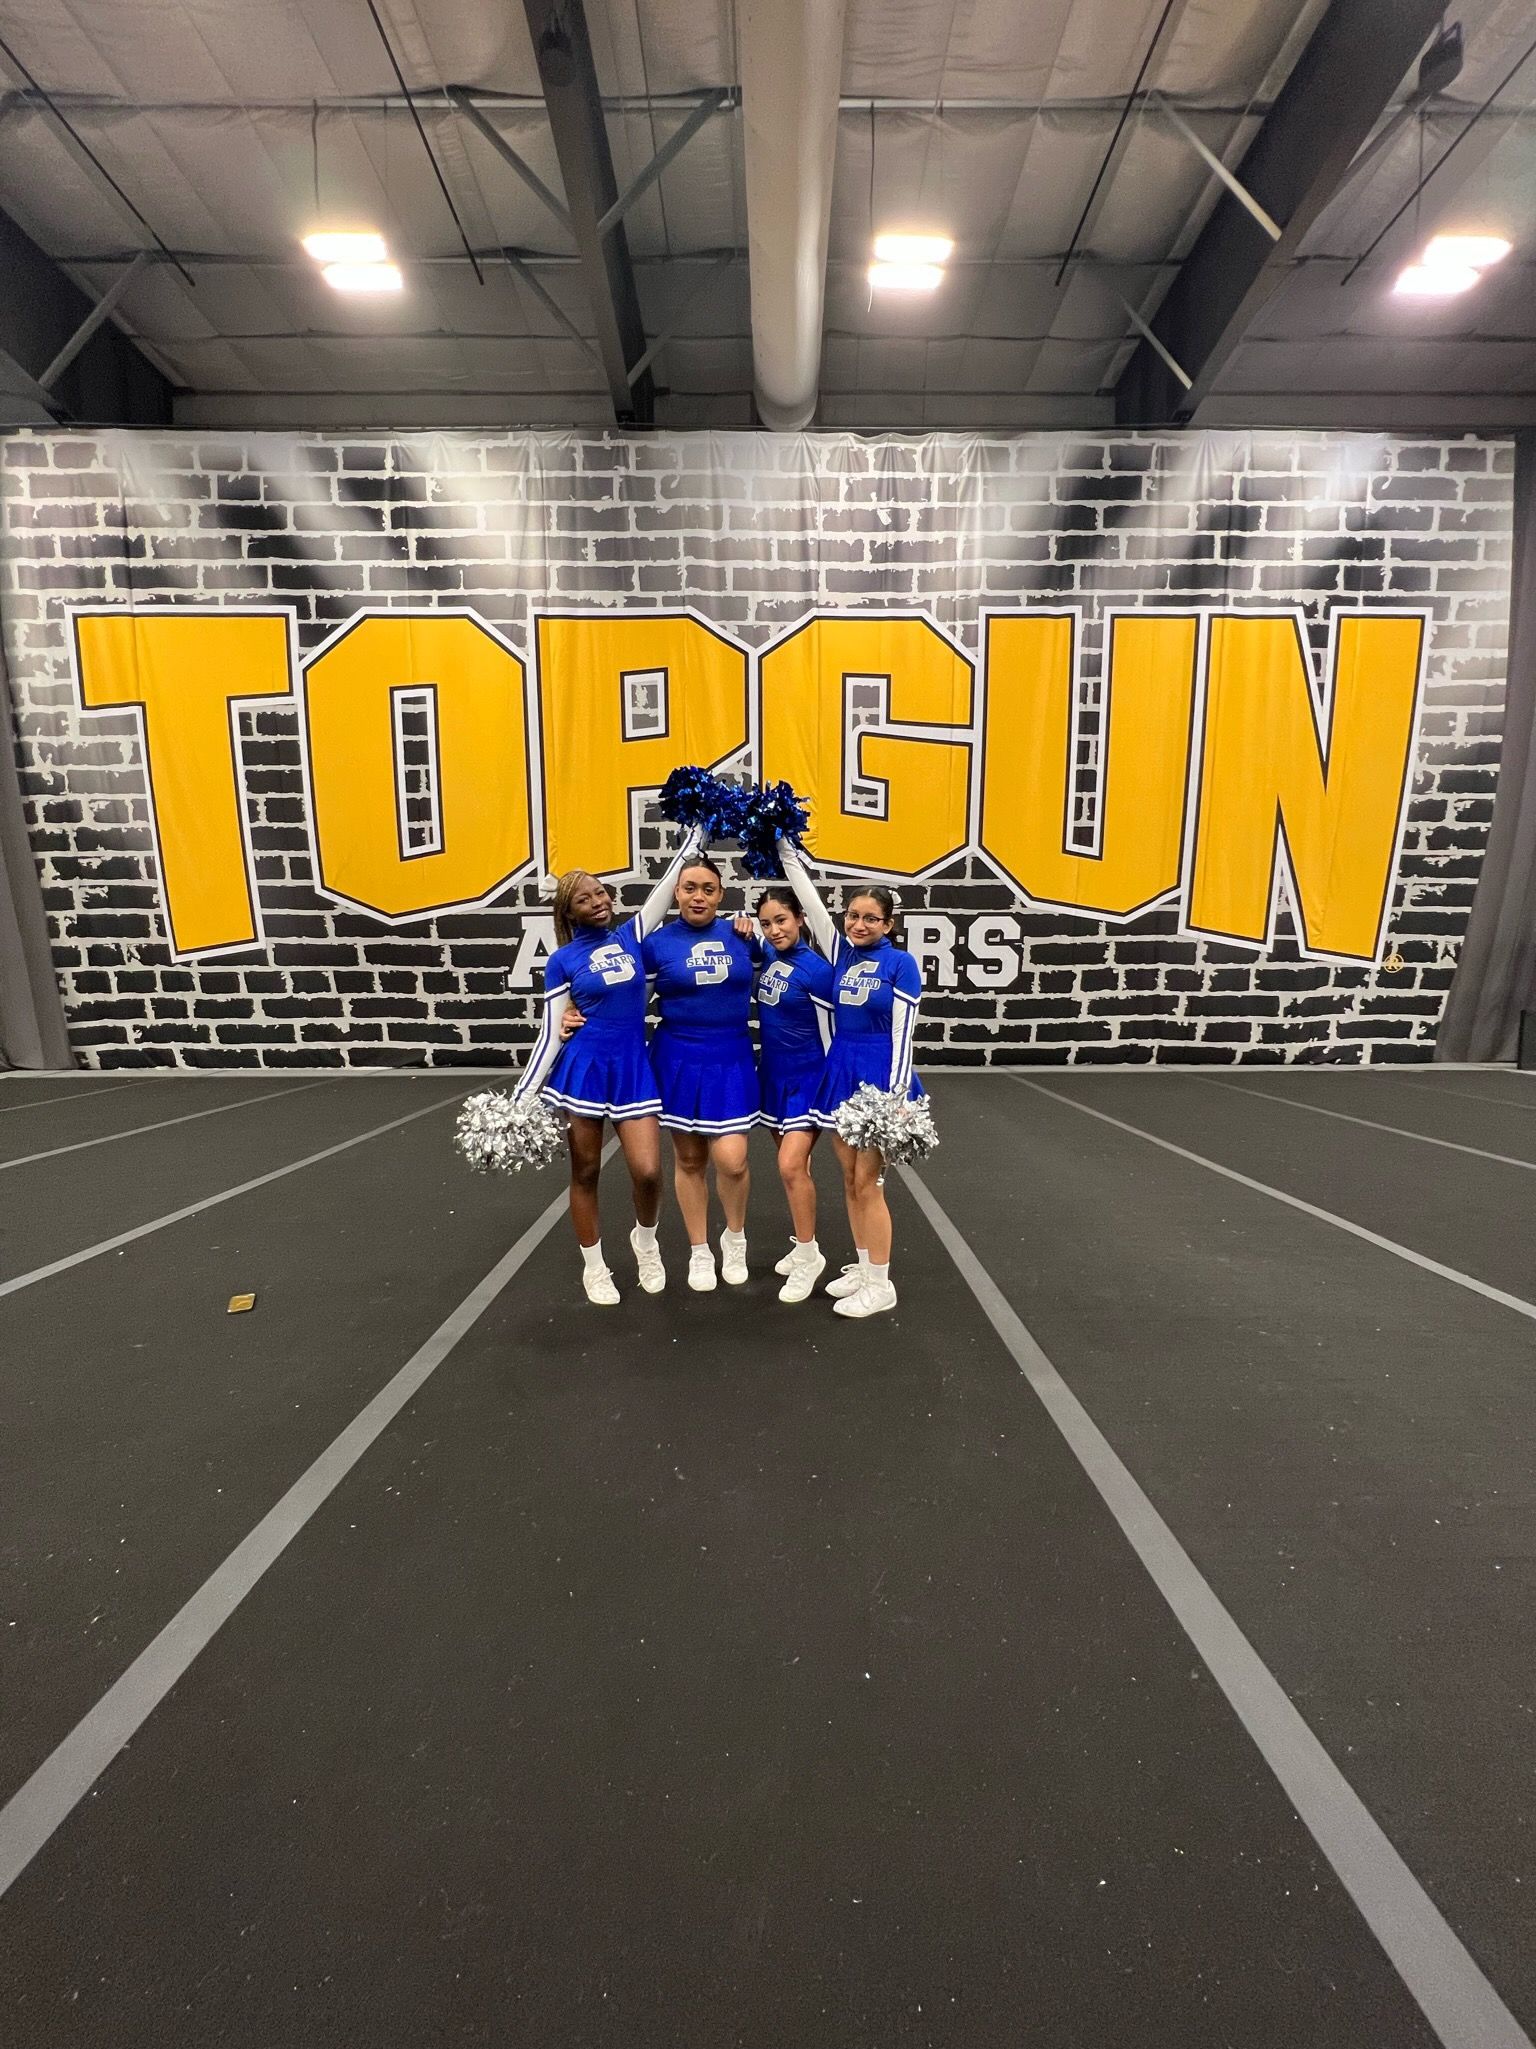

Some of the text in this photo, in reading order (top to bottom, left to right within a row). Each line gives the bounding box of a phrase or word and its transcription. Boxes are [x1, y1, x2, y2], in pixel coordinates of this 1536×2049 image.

[588, 954, 636, 973] SEWARD
[685, 955, 733, 968] SEWARD
[839, 975, 881, 990] SEWARD
